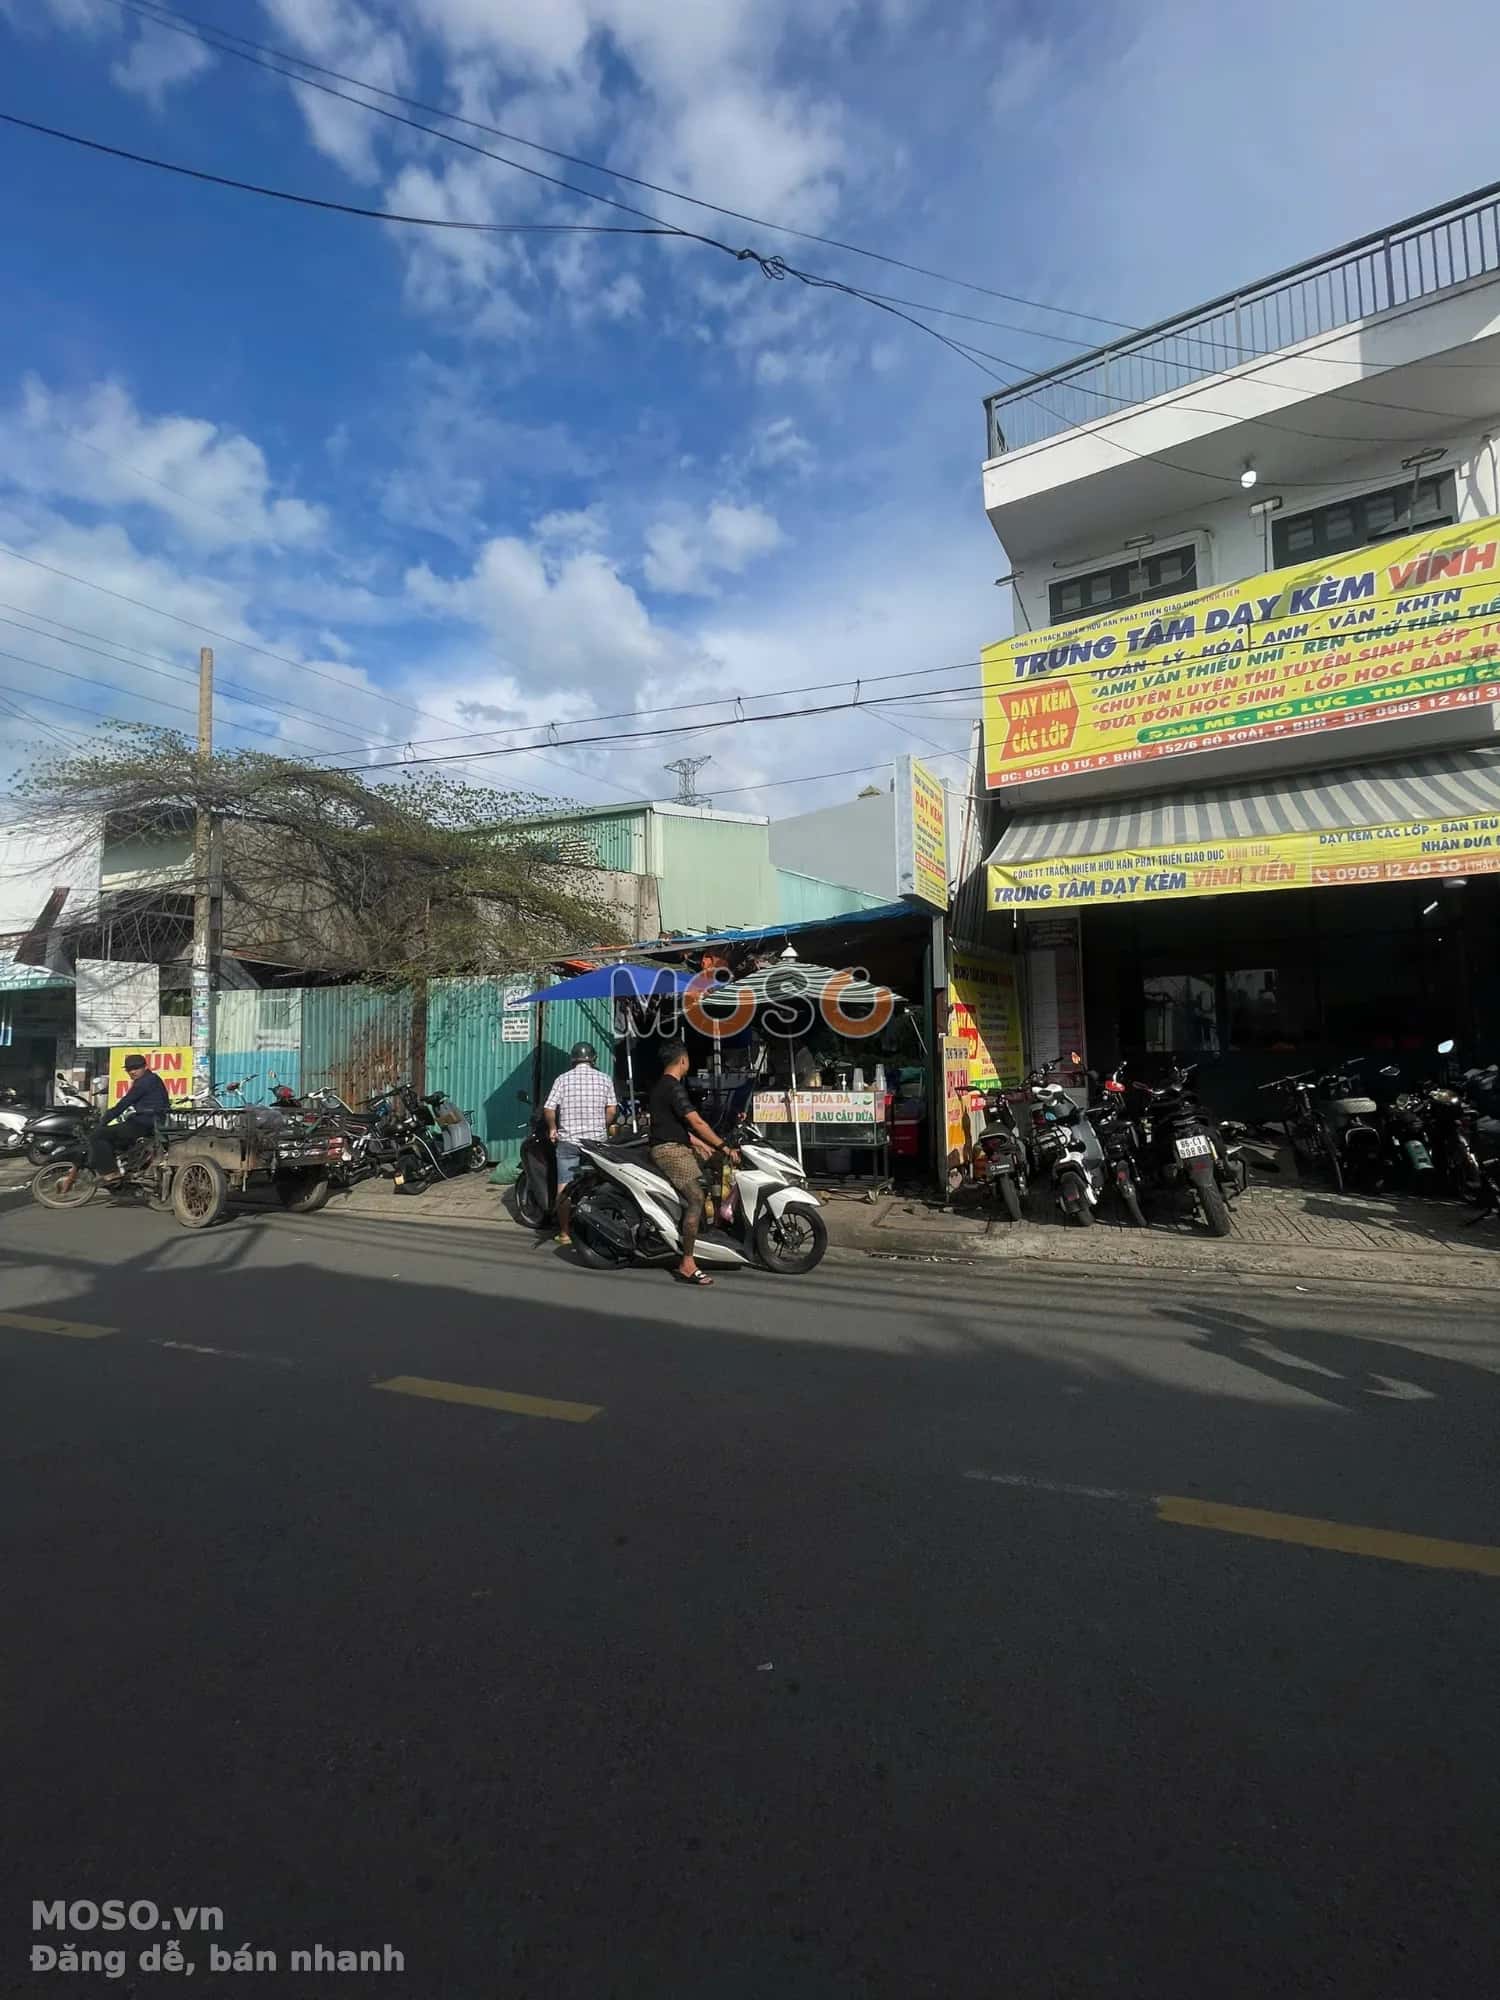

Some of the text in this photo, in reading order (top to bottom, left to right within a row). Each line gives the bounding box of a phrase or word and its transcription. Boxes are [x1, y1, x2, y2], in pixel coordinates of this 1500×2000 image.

[1014, 635, 1117, 678] TRUNG
[1127, 614, 1195, 653] TÂM
[1205, 594, 1283, 635] DẠY
[1289, 571, 1375, 615] KÈM
[1262, 623, 1309, 645] ANH
[1328, 608, 1376, 630] VĂN
[1396, 589, 1462, 615] KHTN
[1097, 679, 1137, 698] ANH
[1142, 670, 1180, 688] VĂN
[1186, 653, 1242, 679] THIẾU
[1247, 647, 1285, 667] NHI
[1098, 690, 1172, 714] CHUYÊN
[1244, 668, 1277, 685] THI
[1358, 639, 1415, 662] SINH
[1189, 694, 1232, 714] HỌC
[1236, 684, 1286, 705] SINH
[1411, 650, 1462, 672] BÁN
[1009, 687, 1073, 725] DẠY KÈM
[1011, 724, 1039, 754] CÁC
[1421, 836, 1460, 854] NHẬN
[993, 884, 1053, 903] TRUNG
[1058, 877, 1096, 899] TÂM
[1100, 875, 1140, 899] DẠY
[1144, 869, 1187, 892] KÈM
[1335, 864, 1380, 881] 0903
[1385, 862, 1403, 878] 12
[1407, 860, 1432, 875] 40
[115, 1078, 188, 1100] MM
[815, 1111, 836, 1121] RAU
